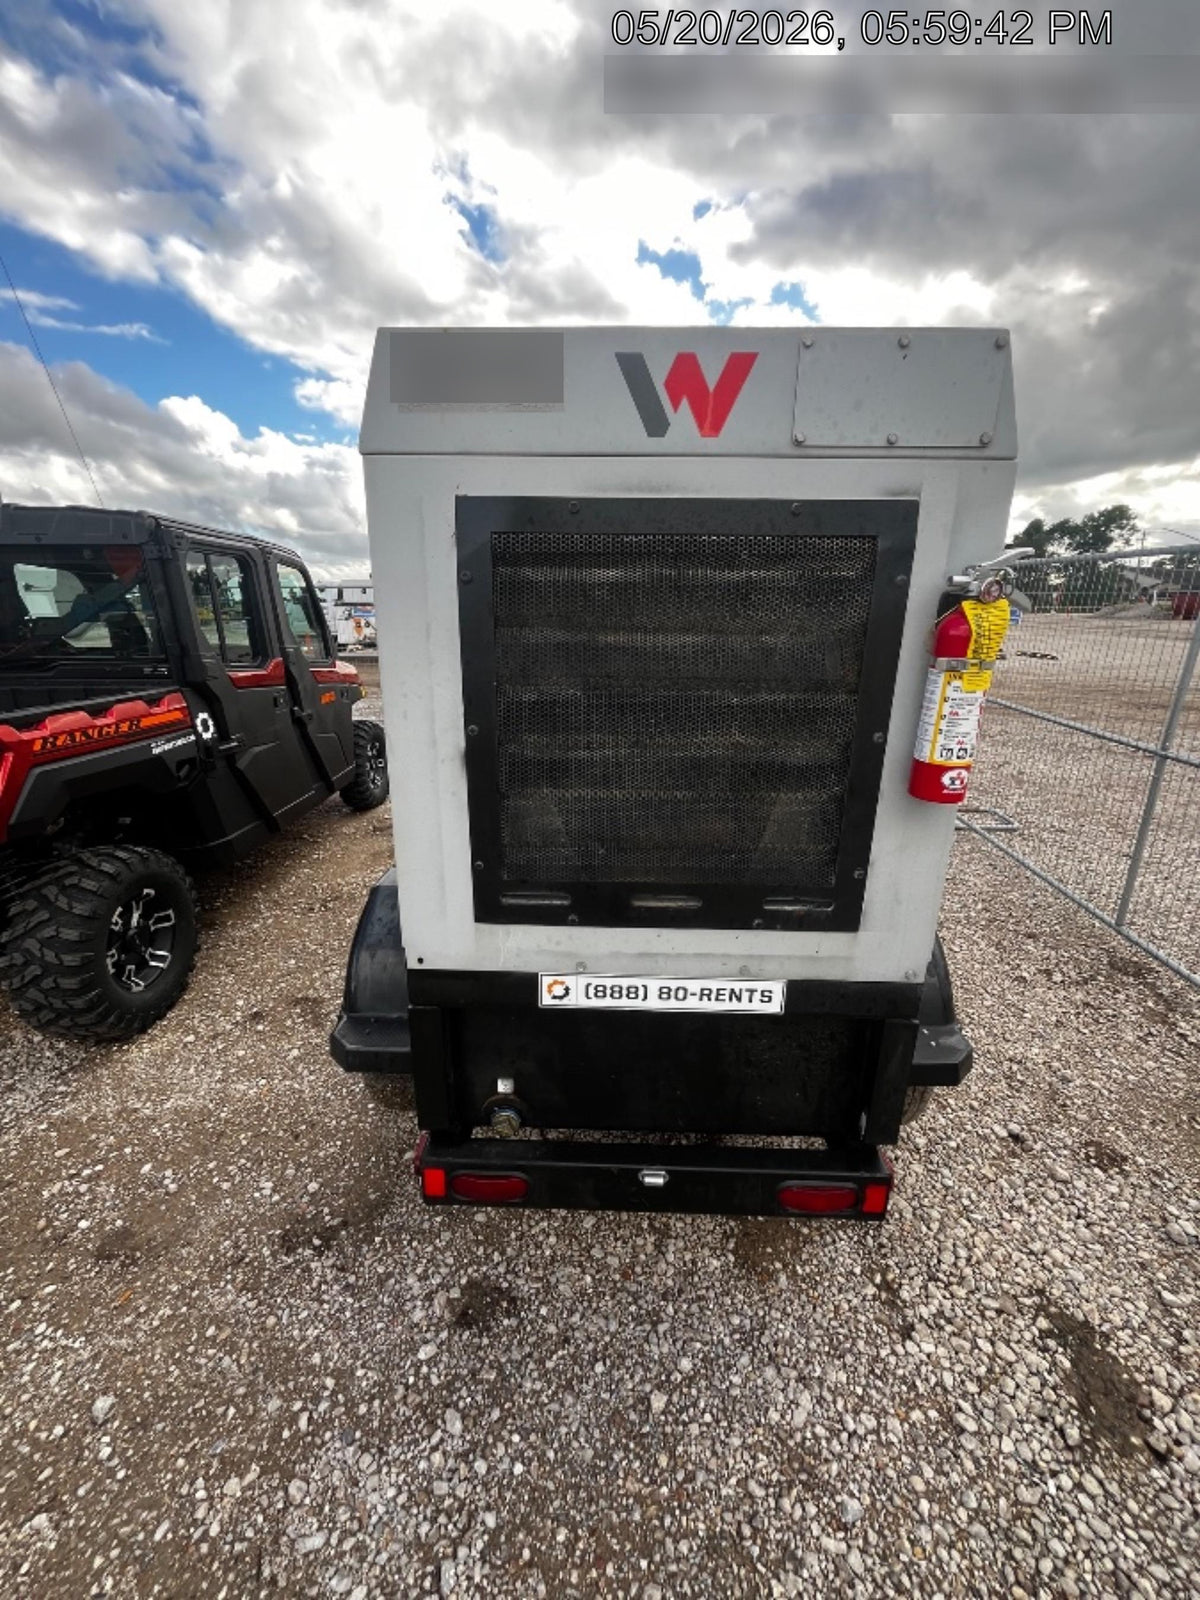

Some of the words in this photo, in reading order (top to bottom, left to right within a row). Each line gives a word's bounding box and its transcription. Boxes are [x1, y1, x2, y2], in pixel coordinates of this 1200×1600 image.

[39, 718, 142, 750] RANGER
[584, 983, 648, 1000] (888)
[658, 986, 773, 1004] 80-RENTS
